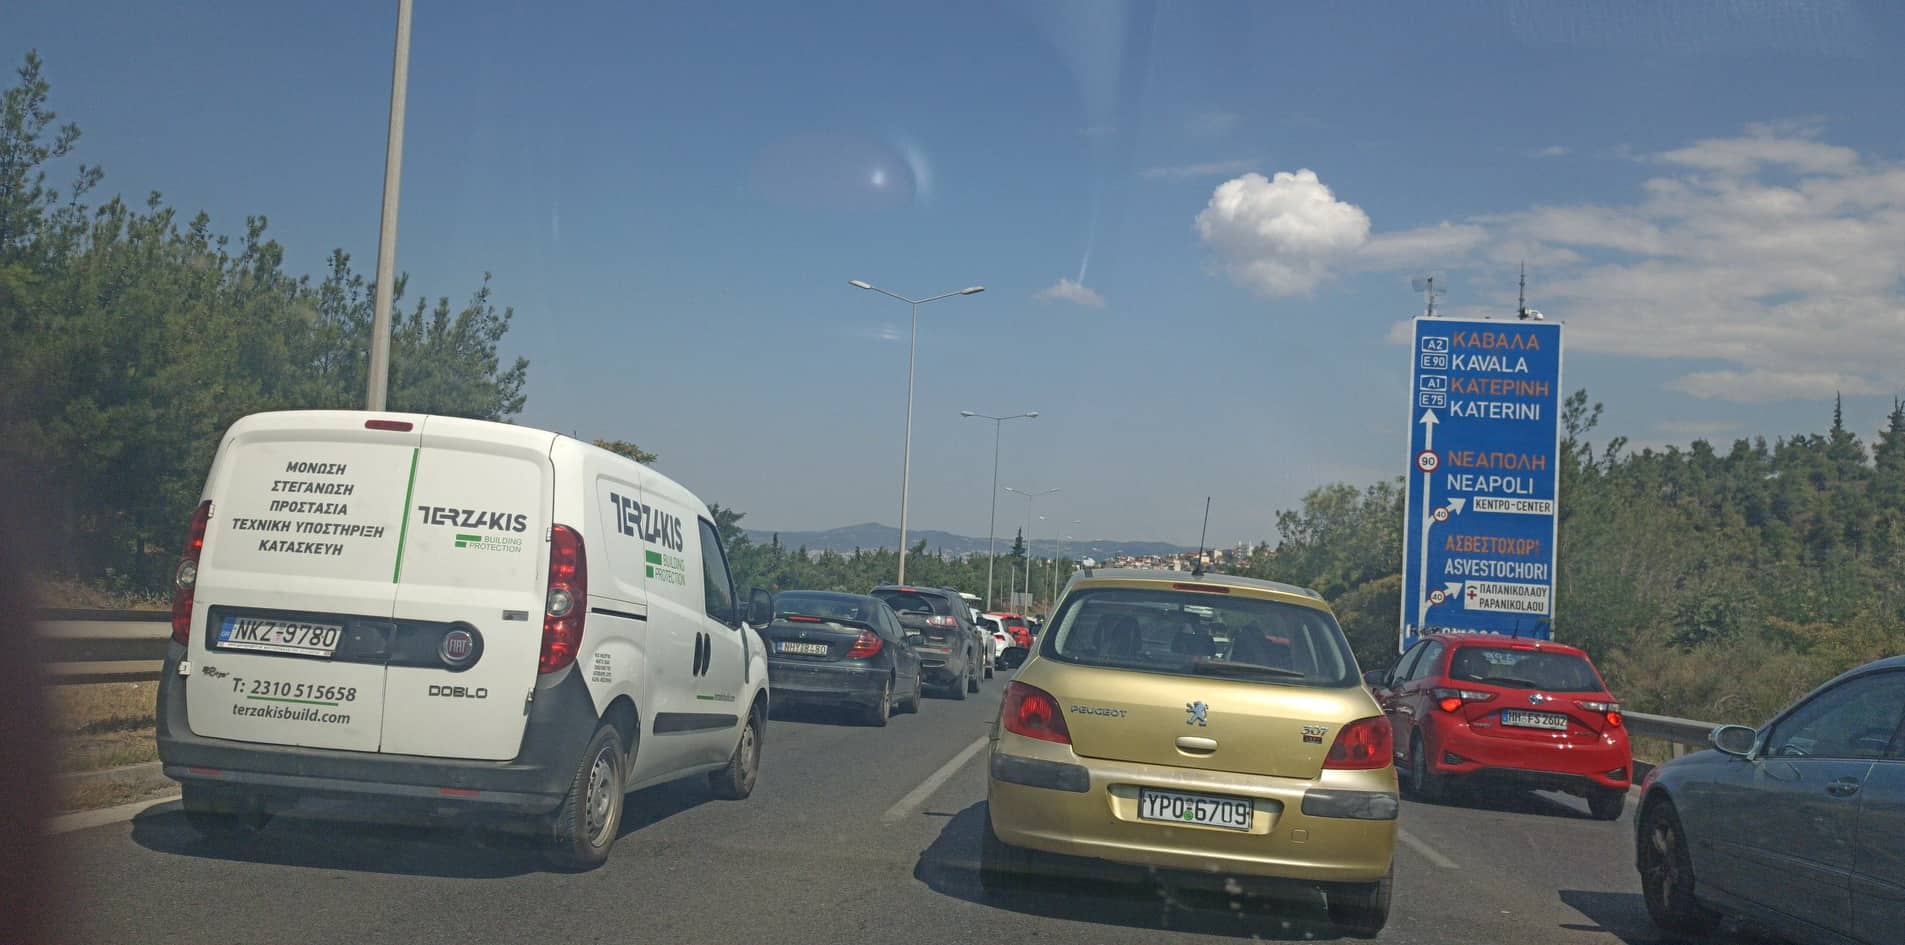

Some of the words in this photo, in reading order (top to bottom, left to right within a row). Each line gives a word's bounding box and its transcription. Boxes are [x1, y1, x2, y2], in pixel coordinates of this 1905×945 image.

[1428, 340, 1443, 350] A2
[1452, 331, 1541, 351] ΚΑΒΑΛΑ
[1451, 354, 1529, 374] KAVALA
[1427, 379, 1440, 388] A1
[1450, 377, 1550, 397] ΚΑΤΕΡΙΝΗ
[1450, 400, 1540, 421] KATERINI
[286, 461, 347, 475] ΜΟΝΩΣΗ
[1421, 456, 1435, 466] 90
[1447, 450, 1546, 471] ΝΕΑΠΟΛΗ
[271, 480, 354, 496] ΣΤΕΓΑΝΩΣΗ
[1447, 473, 1534, 495] NEAPOLI
[269, 500, 348, 516] ΠΡΟΣΤΑΣΙΑ
[1435, 509, 1447, 519] 40
[418, 505, 528, 533] TERZAKIS
[609, 492, 684, 553] TERZAKIS
[232, 518, 292, 532] ΤΕΧΝΙΚΗ
[295, 521, 385, 538] ΥΠΟΣΤΗΡΙΞΗ
[258, 539, 344, 556] ΚΑΤΑΣΚΕΥΗ
[469, 542, 523, 553] PROTECTION
[484, 535, 523, 546] BUILDING
[1444, 558, 1548, 580] ASVESTOCHORI
[1431, 593, 1443, 602] 40
[1479, 583, 1548, 598] ΠΑΠΑΝΙΚΟΛΑΟΥ
[1479, 597, 1544, 612] PAPANIKOLAOU
[449, 639, 467, 654] FIAT
[233, 677, 245, 693] T:
[250, 680, 292, 697] 2310
[294, 684, 357, 702] 515658
[428, 684, 488, 699] DOBLO
[232, 703, 350, 724] terzakisbuild.com
[1071, 704, 1127, 718] PEUGEOT
[1301, 725, 1329, 737] 307
